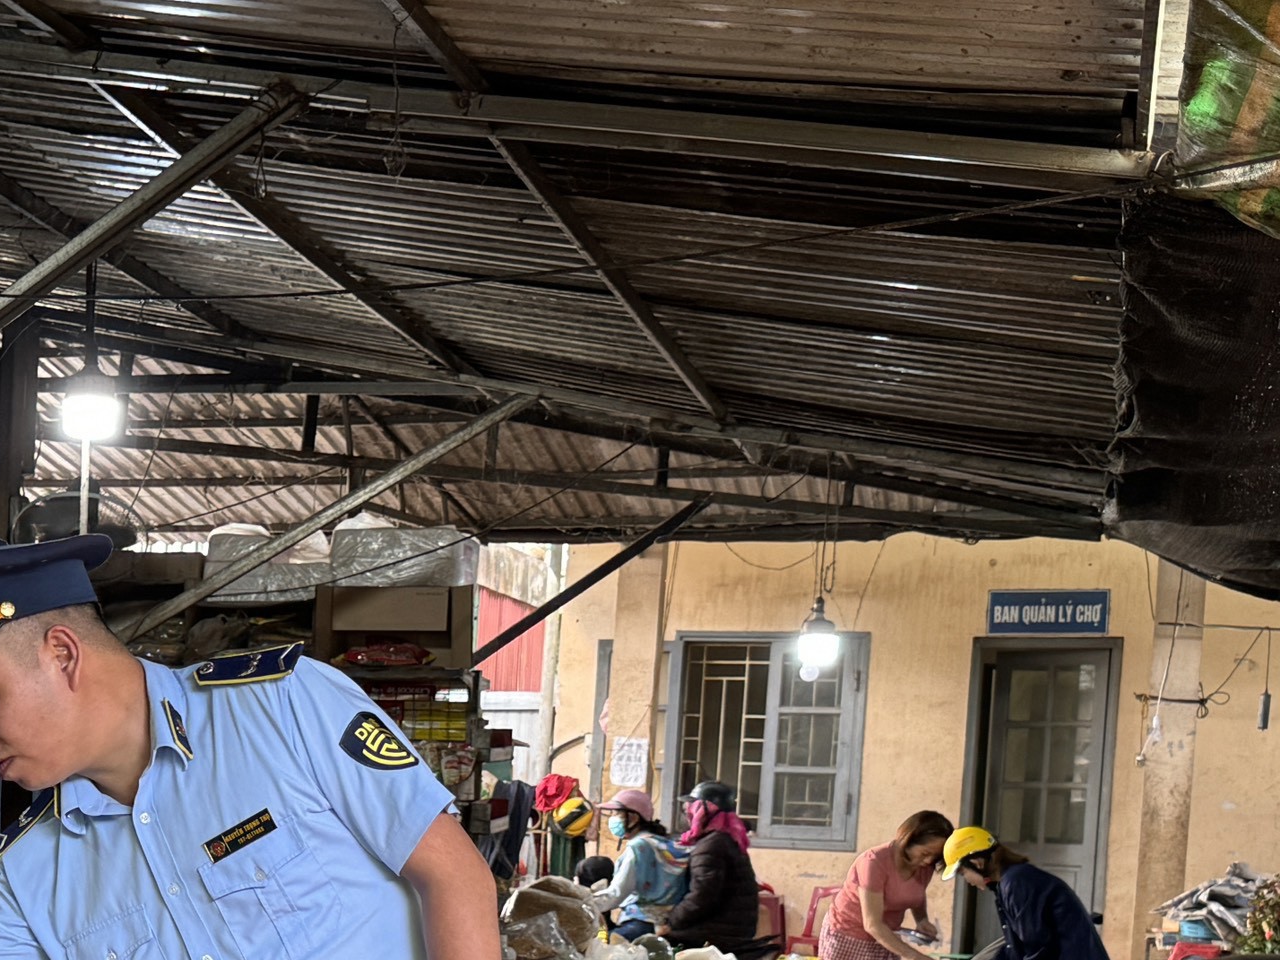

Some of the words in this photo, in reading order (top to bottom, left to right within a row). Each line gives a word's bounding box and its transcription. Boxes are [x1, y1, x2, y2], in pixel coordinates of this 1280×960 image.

[993, 605, 1019, 623] BAN
[1022, 598, 1056, 625] QUẢN
[1058, 600, 1074, 623] LÝ
[1075, 604, 1102, 627] CHỢ
